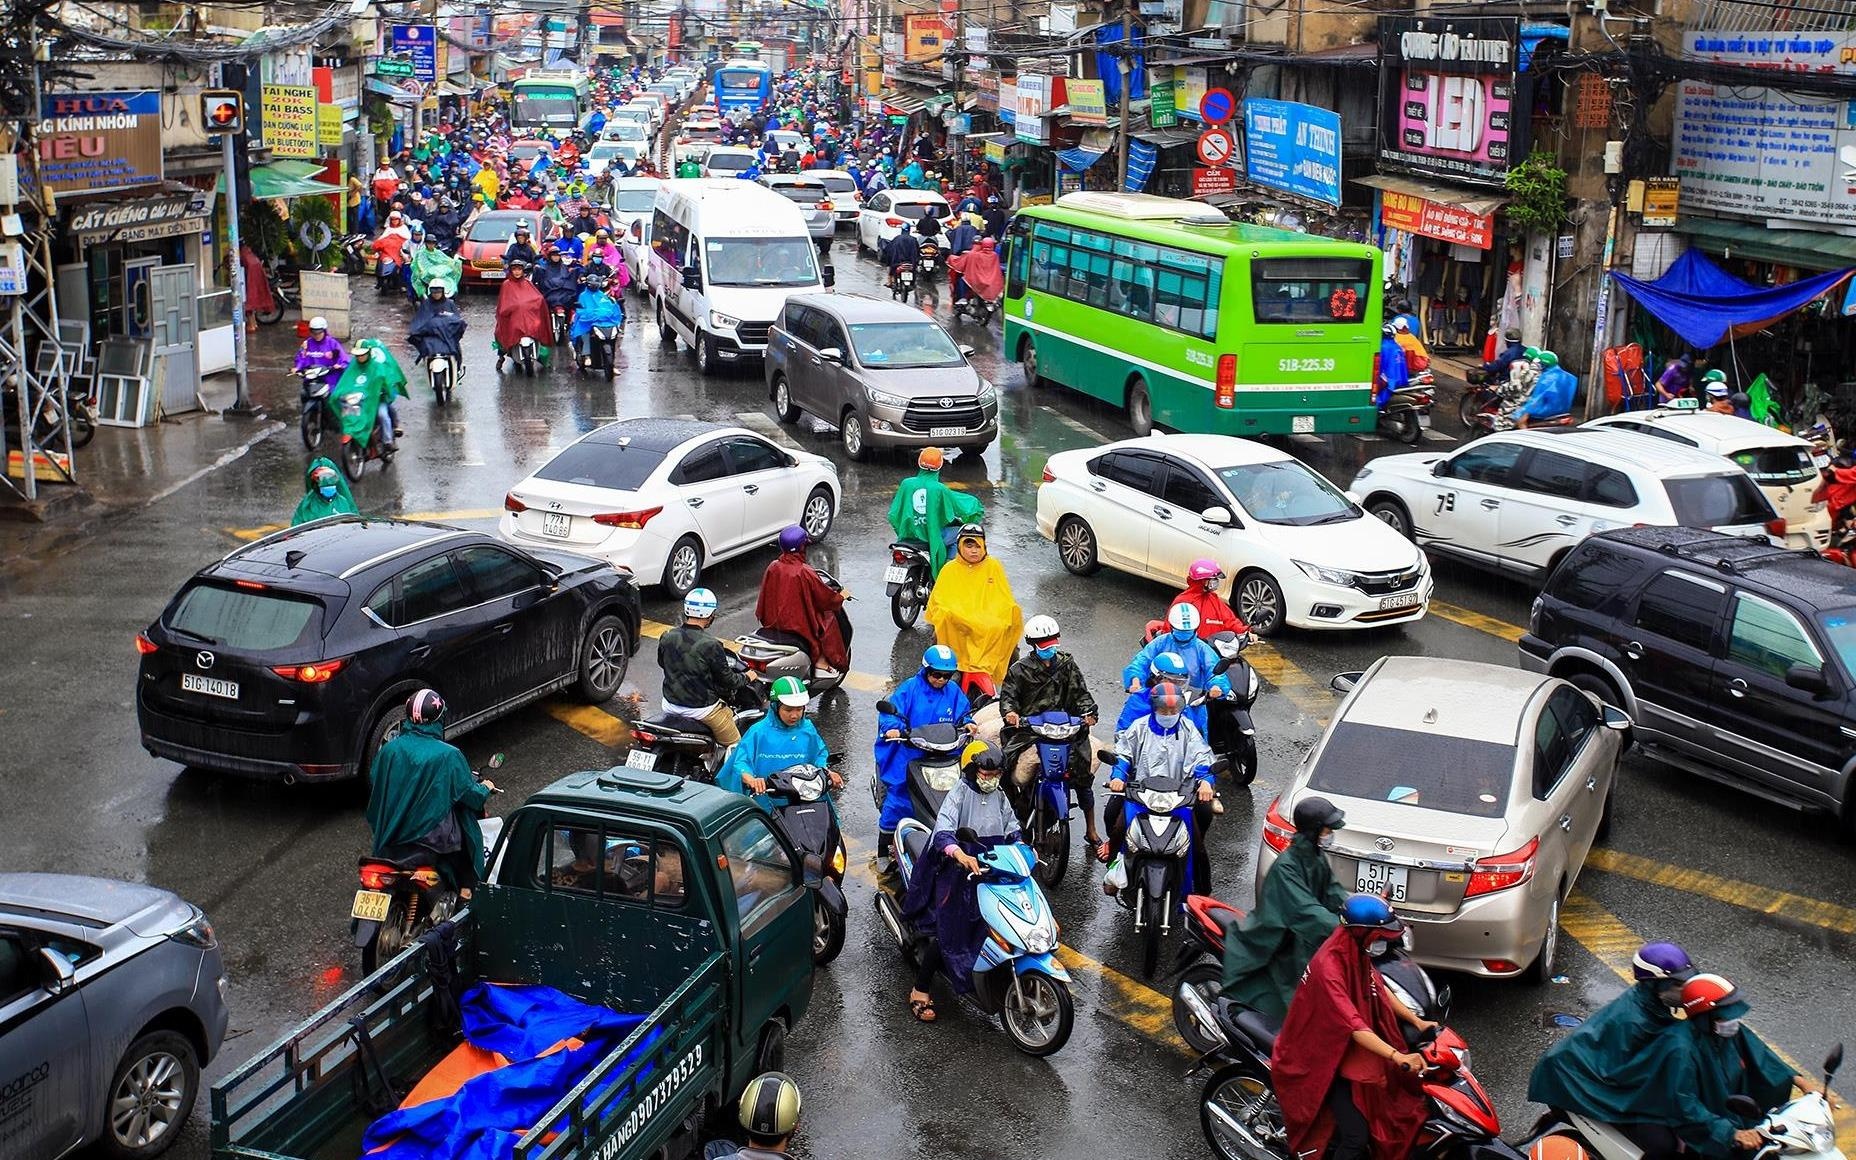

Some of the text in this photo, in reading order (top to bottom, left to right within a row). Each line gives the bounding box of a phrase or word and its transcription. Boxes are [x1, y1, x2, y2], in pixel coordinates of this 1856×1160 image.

[263, 87, 313, 98] TAI NGHE
[272, 96, 304, 104] 20K
[285, 105, 313, 114] BASS
[57, 114, 94, 132] KÍNH
[96, 112, 138, 130] NHÔM
[277, 139, 314, 147] BLUETOOTH
[72, 210, 104, 231] CẮT
[103, 204, 148, 227] KIẾNG
[150, 201, 167, 219] CÁC
[1331, 289, 1356, 317] 62
[1279, 358, 1335, 371] 51B-225.39
[551, 514, 564, 525] 77A
[1198, 525, 1221, 536] JACKSON
[1369, 864, 1396, 881] 51F
[357, 905, 383, 918] 0468
